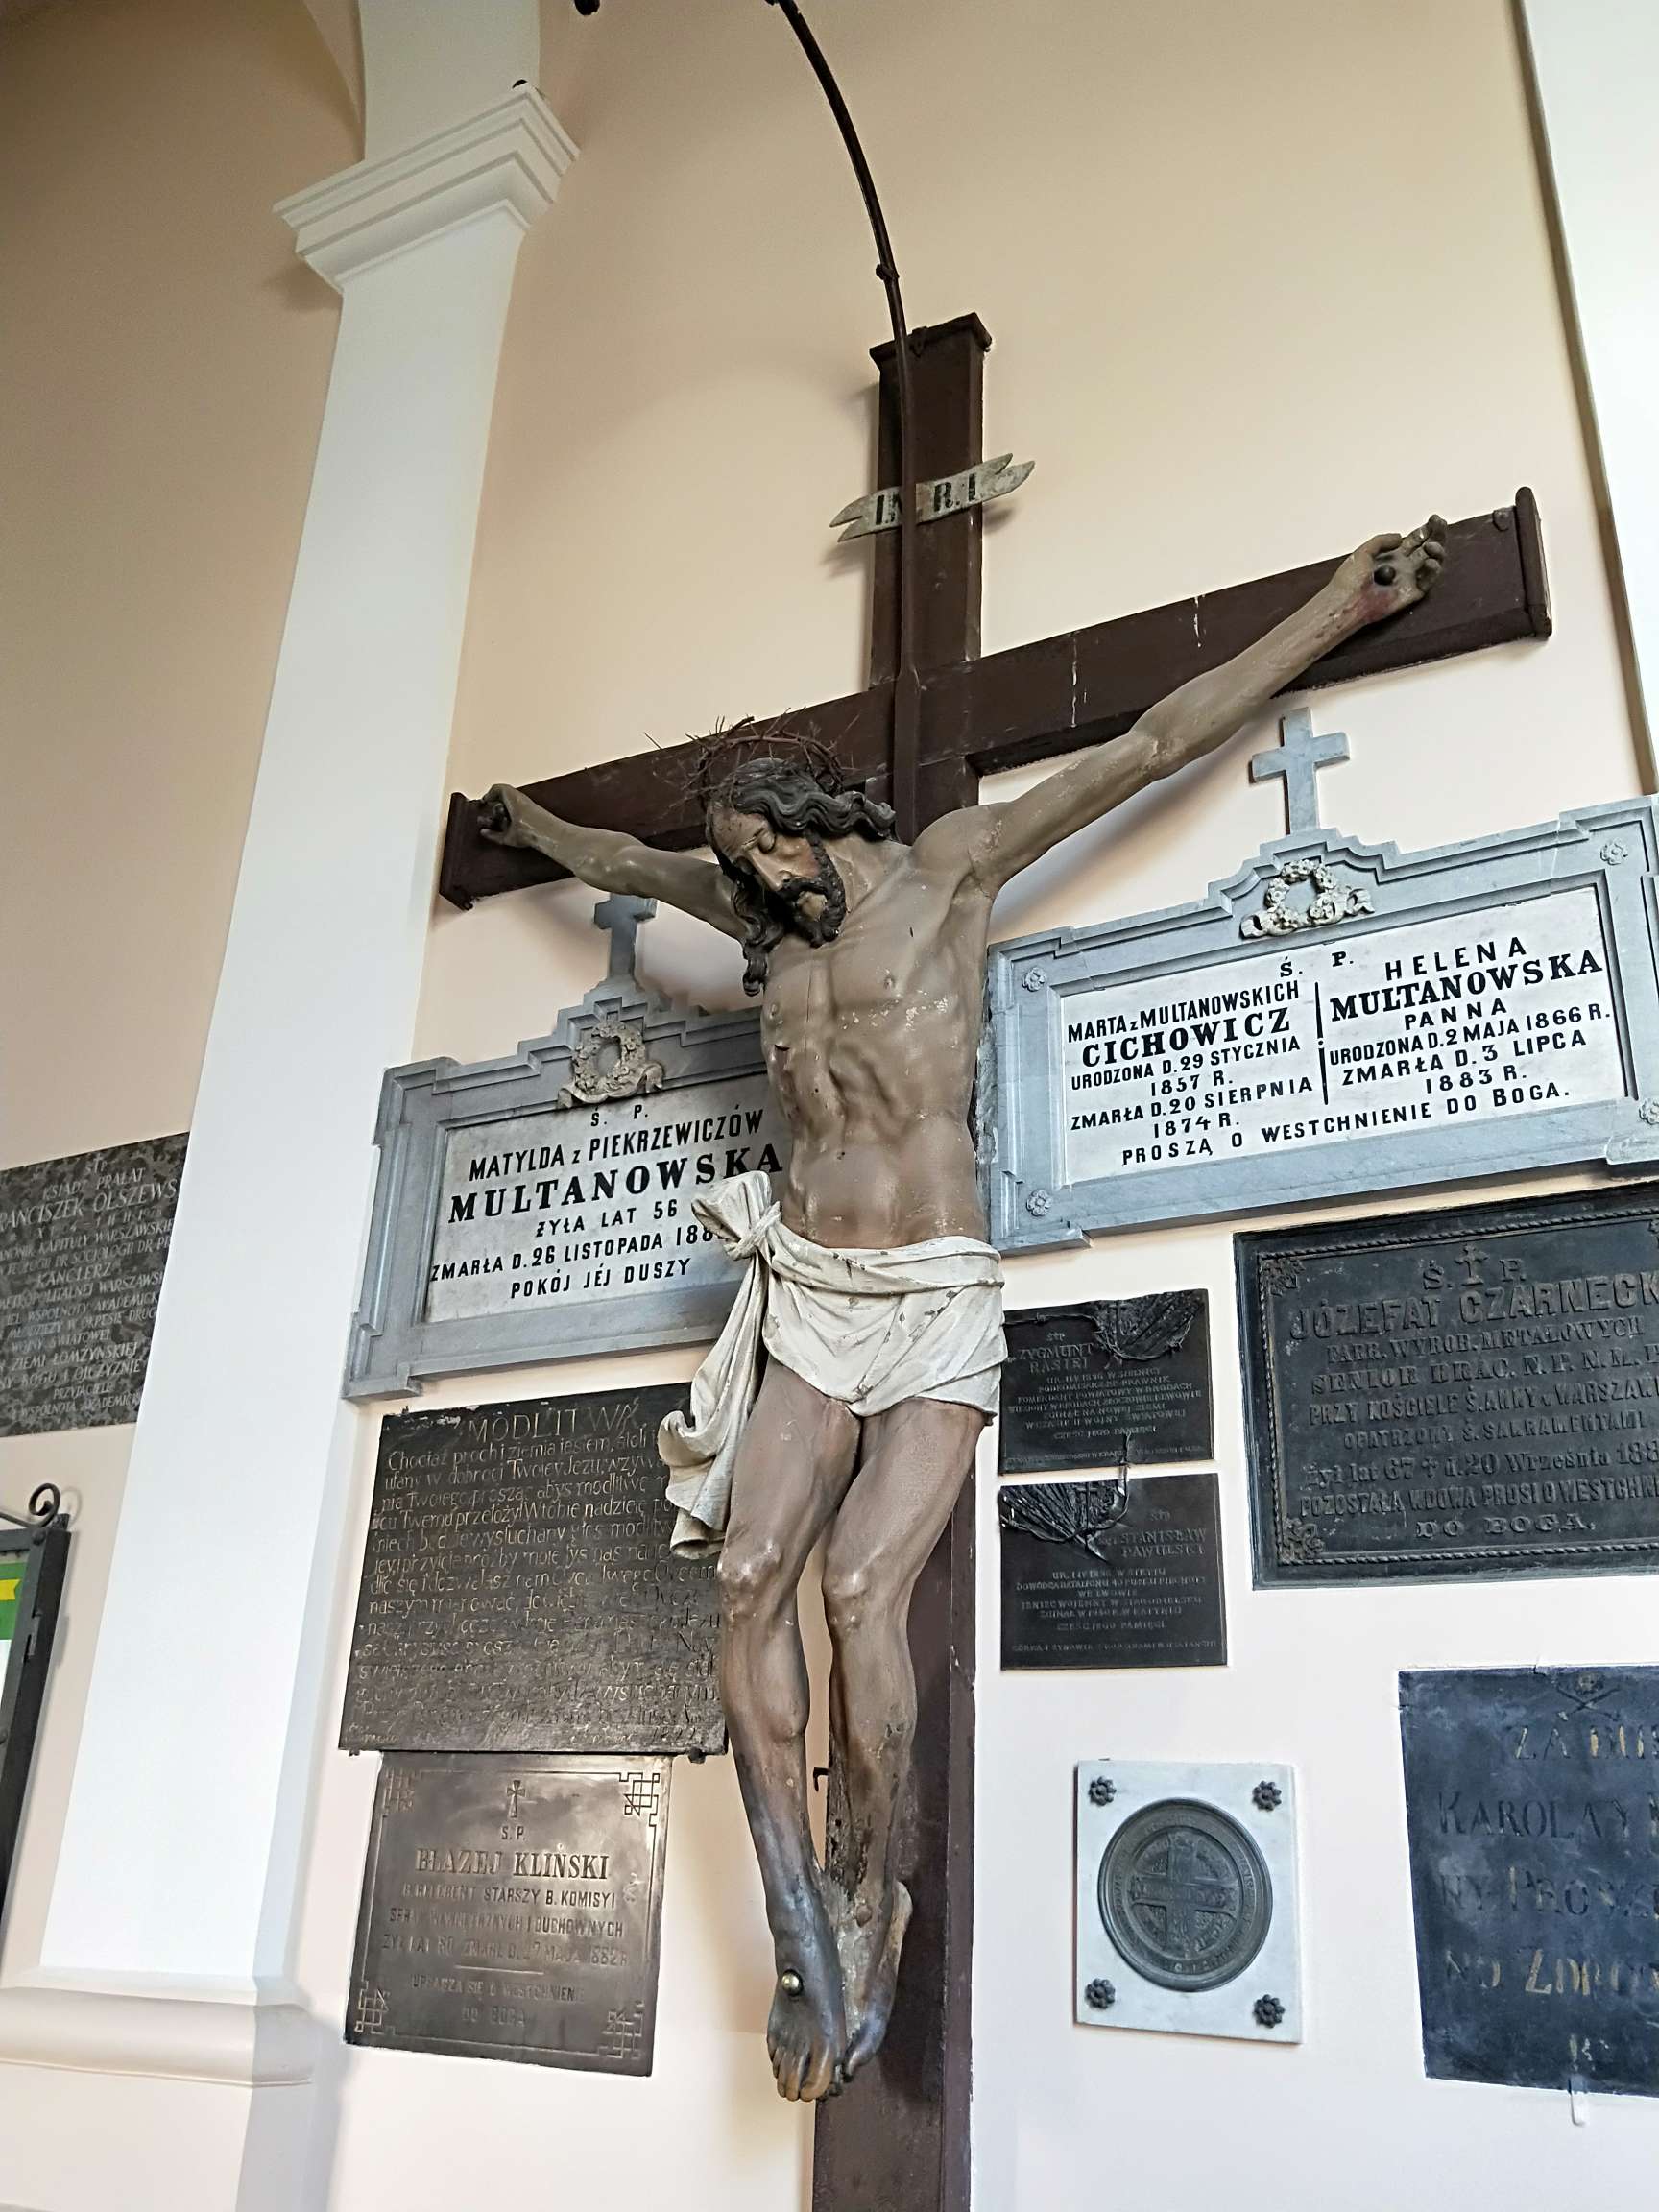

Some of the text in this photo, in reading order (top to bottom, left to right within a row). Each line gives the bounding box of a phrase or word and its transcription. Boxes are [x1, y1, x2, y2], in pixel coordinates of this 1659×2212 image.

[1280, 950, 1354, 978] Ś. P.
[1384, 936, 1527, 981] HELENA
[1330, 950, 1603, 1022] MULTANOWSKA
[1068, 1015, 1127, 1043] MARTA
[1140, 980, 1299, 1029] MULTANOWSKICH
[1330, 1035, 1423, 1066] URODZONA
[1463, 1018, 1520, 1043] MAJA
[1527, 1006, 1582, 1031] 1866
[1588, 1003, 1611, 1021] R.
[1405, 998, 1507, 1031] PANNA
[1082, 1006, 1290, 1068] CICHOWICZ
[1340, 1029, 1587, 1086] ZMARŁA D. 3 LIPCA
[1070, 1062, 1154, 1091] URODZONA
[1210, 1035, 1301, 1066] STYCZNIA
[1151, 1070, 1233, 1096] 1857 R.
[1426, 1064, 1527, 1094] 1883 R.
[590, 1104, 649, 1127] Ś. P.
[1070, 1105, 1144, 1130] ZMARŁA
[1204, 1076, 1313, 1109] SIERPNIA
[1122, 1082, 1571, 1166] PROSZĄ O WESTCHNIENIE DO BOGA.
[1154, 1112, 1240, 1138] 1874 R.
[469, 1103, 764, 1182] MATYLDA z PIEKRZEWICZÓW
[447, 1143, 783, 1224] MULTANOWSKA
[601, 1207, 637, 1228] LAT
[653, 1198, 678, 1220] 56
[429, 1256, 503, 1282] ZMARŁA
[565, 1232, 663, 1262] LISTOPADA
[511, 1268, 571, 1299] POKÓJ
[623, 1258, 691, 1284] DUSZY
[1289, 1294, 1442, 1341] JÓZEFAT
[1309, 1401, 1359, 1427] PRZY
[513, 1842, 611, 1880] KLIŃSKI
[483, 1886, 541, 1906] STARSZY
[561, 1889, 615, 1909] KOMISYI
